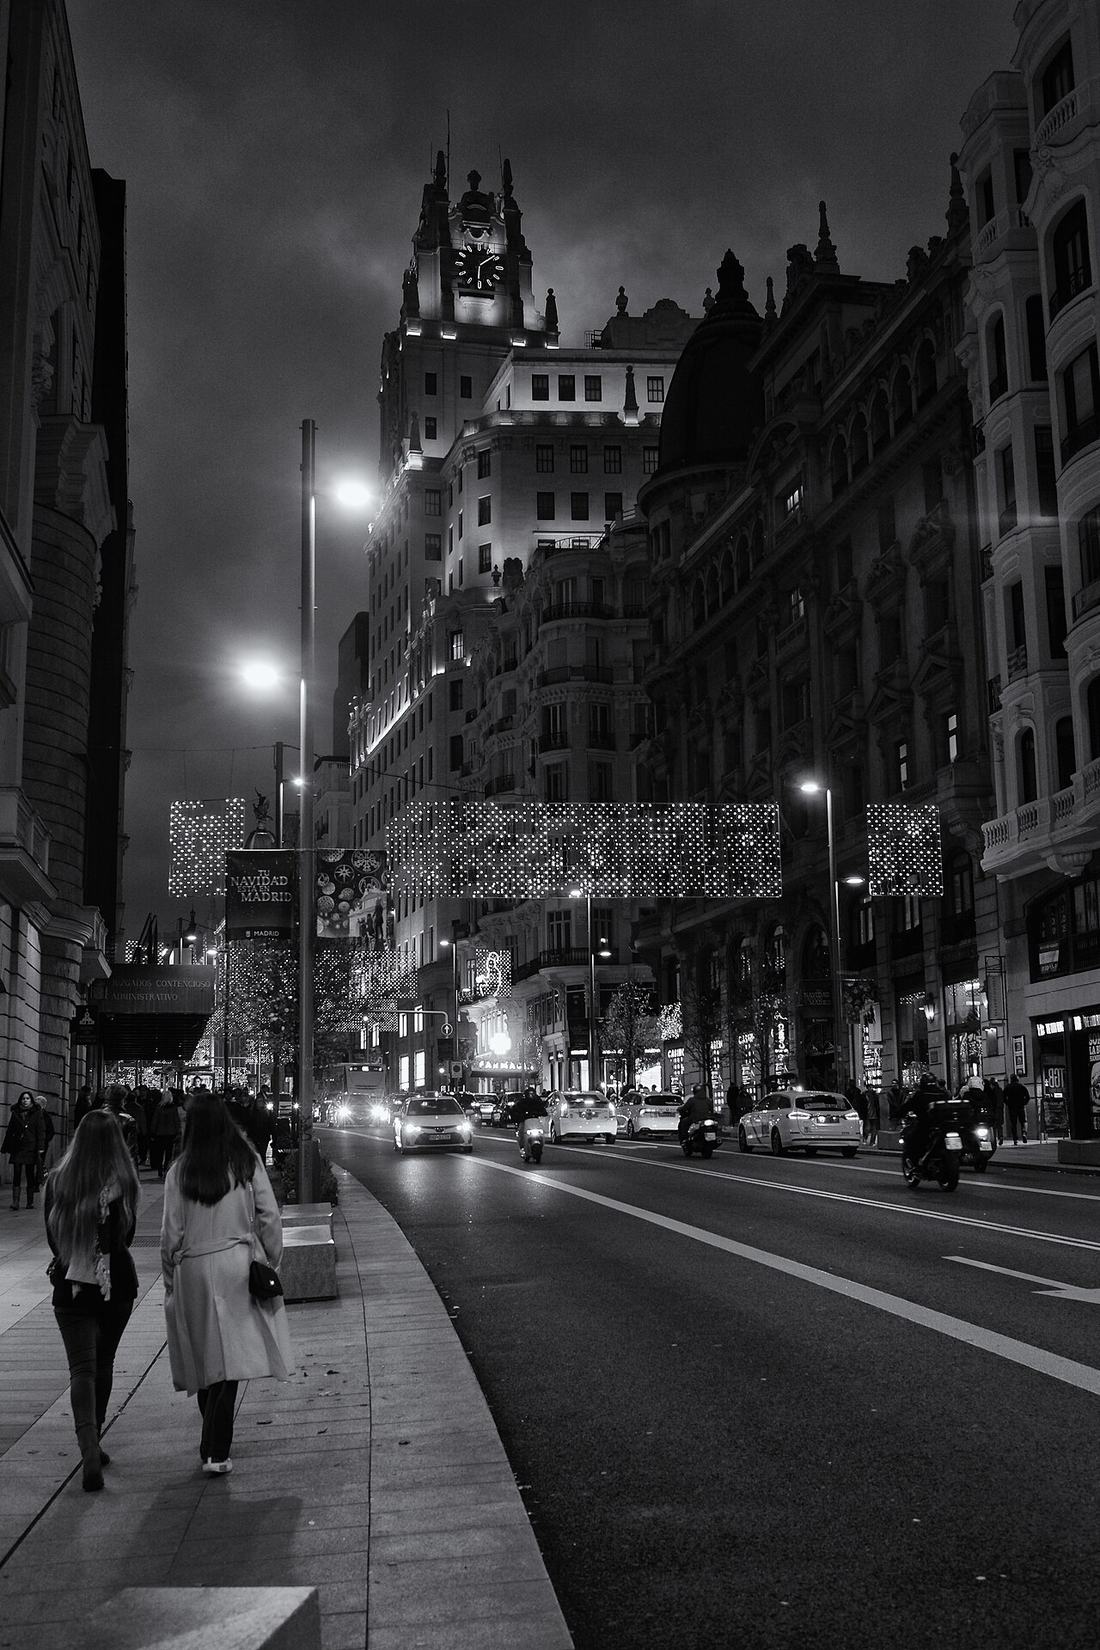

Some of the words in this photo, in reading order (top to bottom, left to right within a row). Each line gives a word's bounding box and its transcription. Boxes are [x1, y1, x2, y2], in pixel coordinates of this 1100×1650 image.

[230, 875, 288, 886] NAVIDAD
[241, 891, 292, 902] MADRID
[155, 979, 211, 988] CONTENCIOSO
[111, 993, 178, 1001] ADMINISTRATIVO
